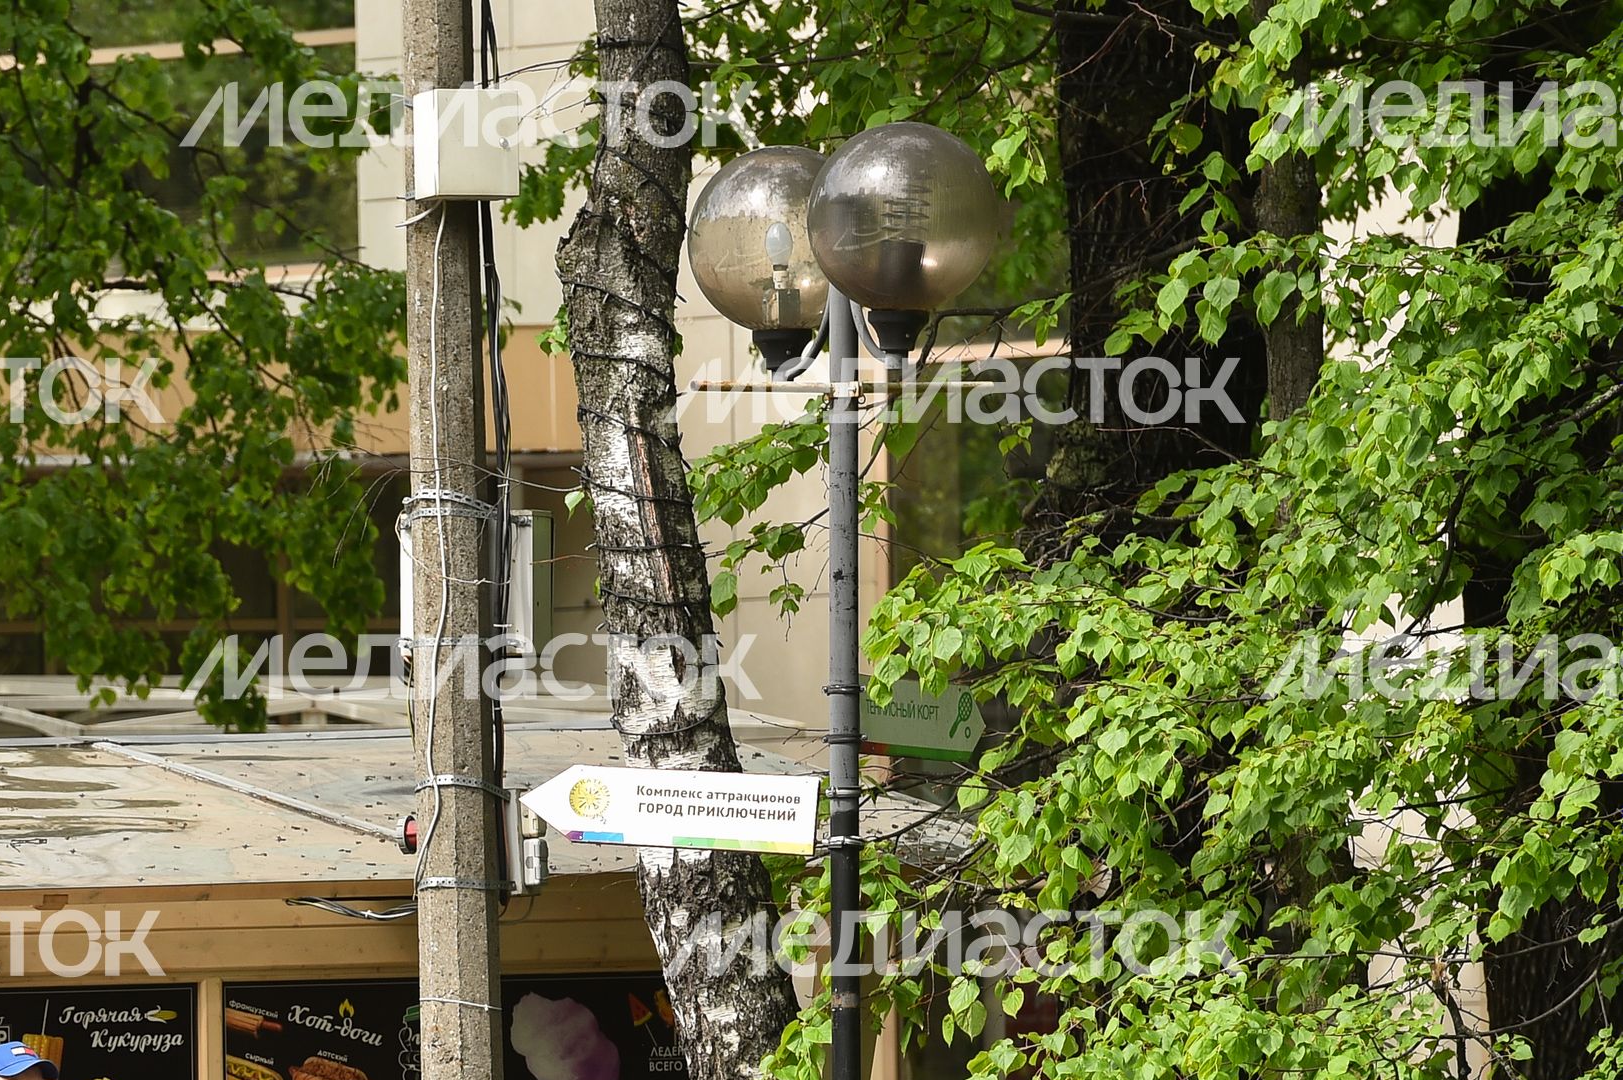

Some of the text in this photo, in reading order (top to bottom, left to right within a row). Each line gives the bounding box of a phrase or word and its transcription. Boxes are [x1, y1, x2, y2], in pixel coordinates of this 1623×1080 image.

[918, 705, 940, 720] КОРТ
[636, 785, 801, 805] Комплекс аттракционов
[638, 802, 797, 822] ГОРОД ПРИКЛЮЧЕНИЙ
[58, 1005, 144, 1030] Горячая
[228, 1000, 279, 1019] французский
[287, 1004, 384, 1047] Хот-доги
[89, 1028, 185, 1053] Кукуруза
[245, 1052, 275, 1066] сырный
[317, 1049, 348, 1064] датский
[649, 1060, 683, 1072] ВСЕГО
